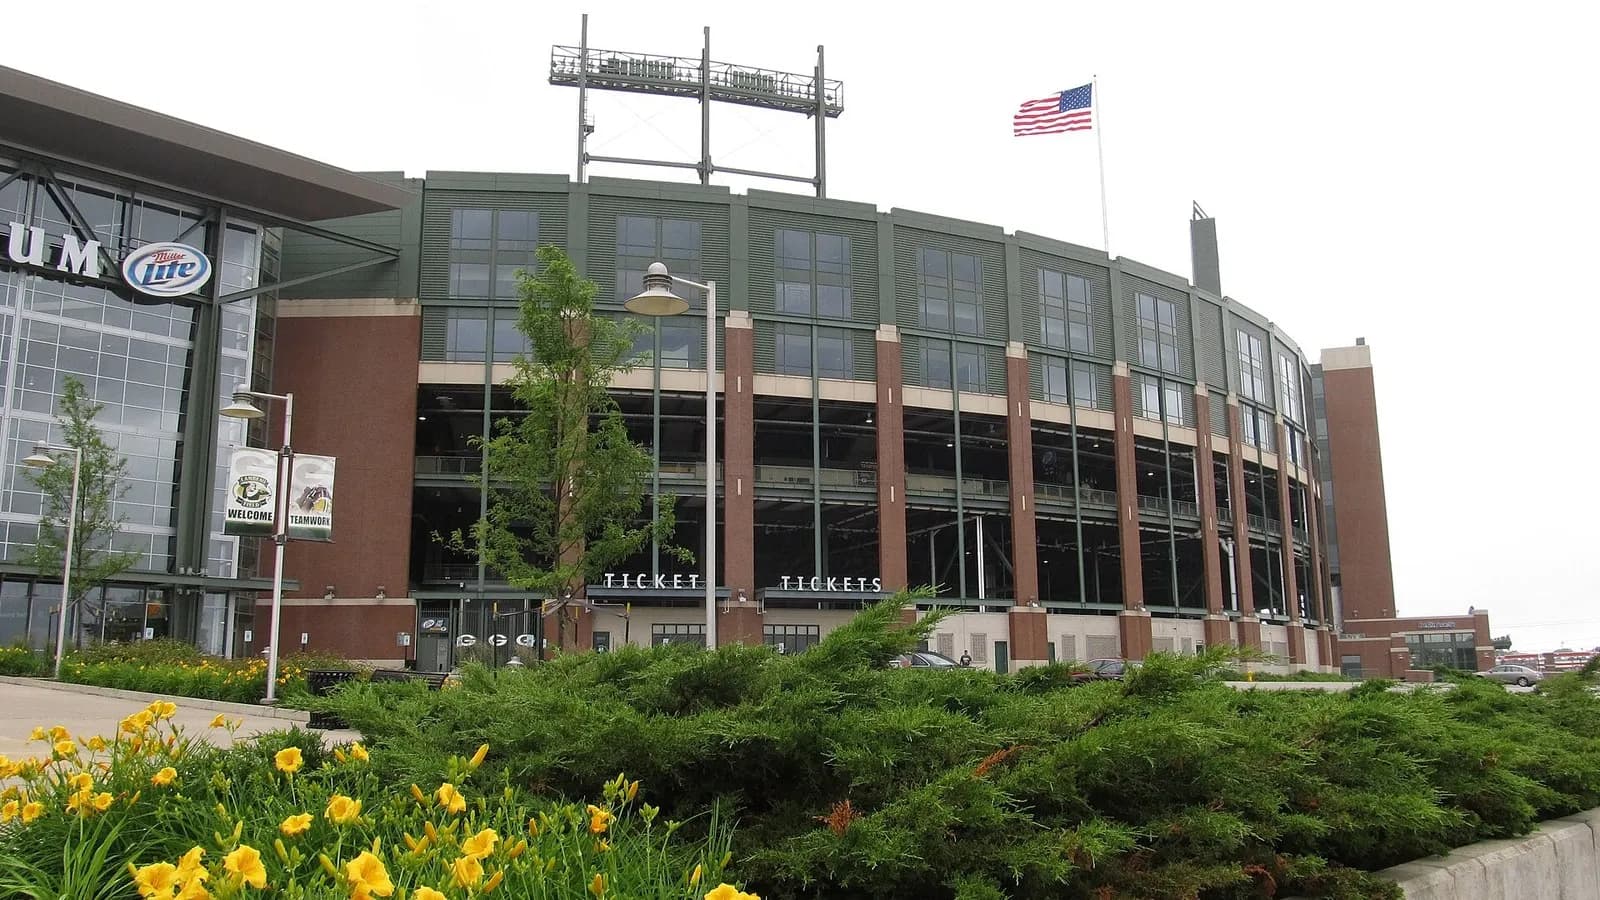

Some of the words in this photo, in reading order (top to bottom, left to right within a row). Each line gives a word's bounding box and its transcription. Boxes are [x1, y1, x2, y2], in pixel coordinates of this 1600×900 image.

[152, 252, 186, 262] Miller
[142, 262, 196, 285] Lite
[228, 509, 272, 520] WELCOME
[290, 515, 330, 526] TEAMWORK
[604, 573, 699, 588] TICKET
[781, 575, 881, 592] TICKETS
